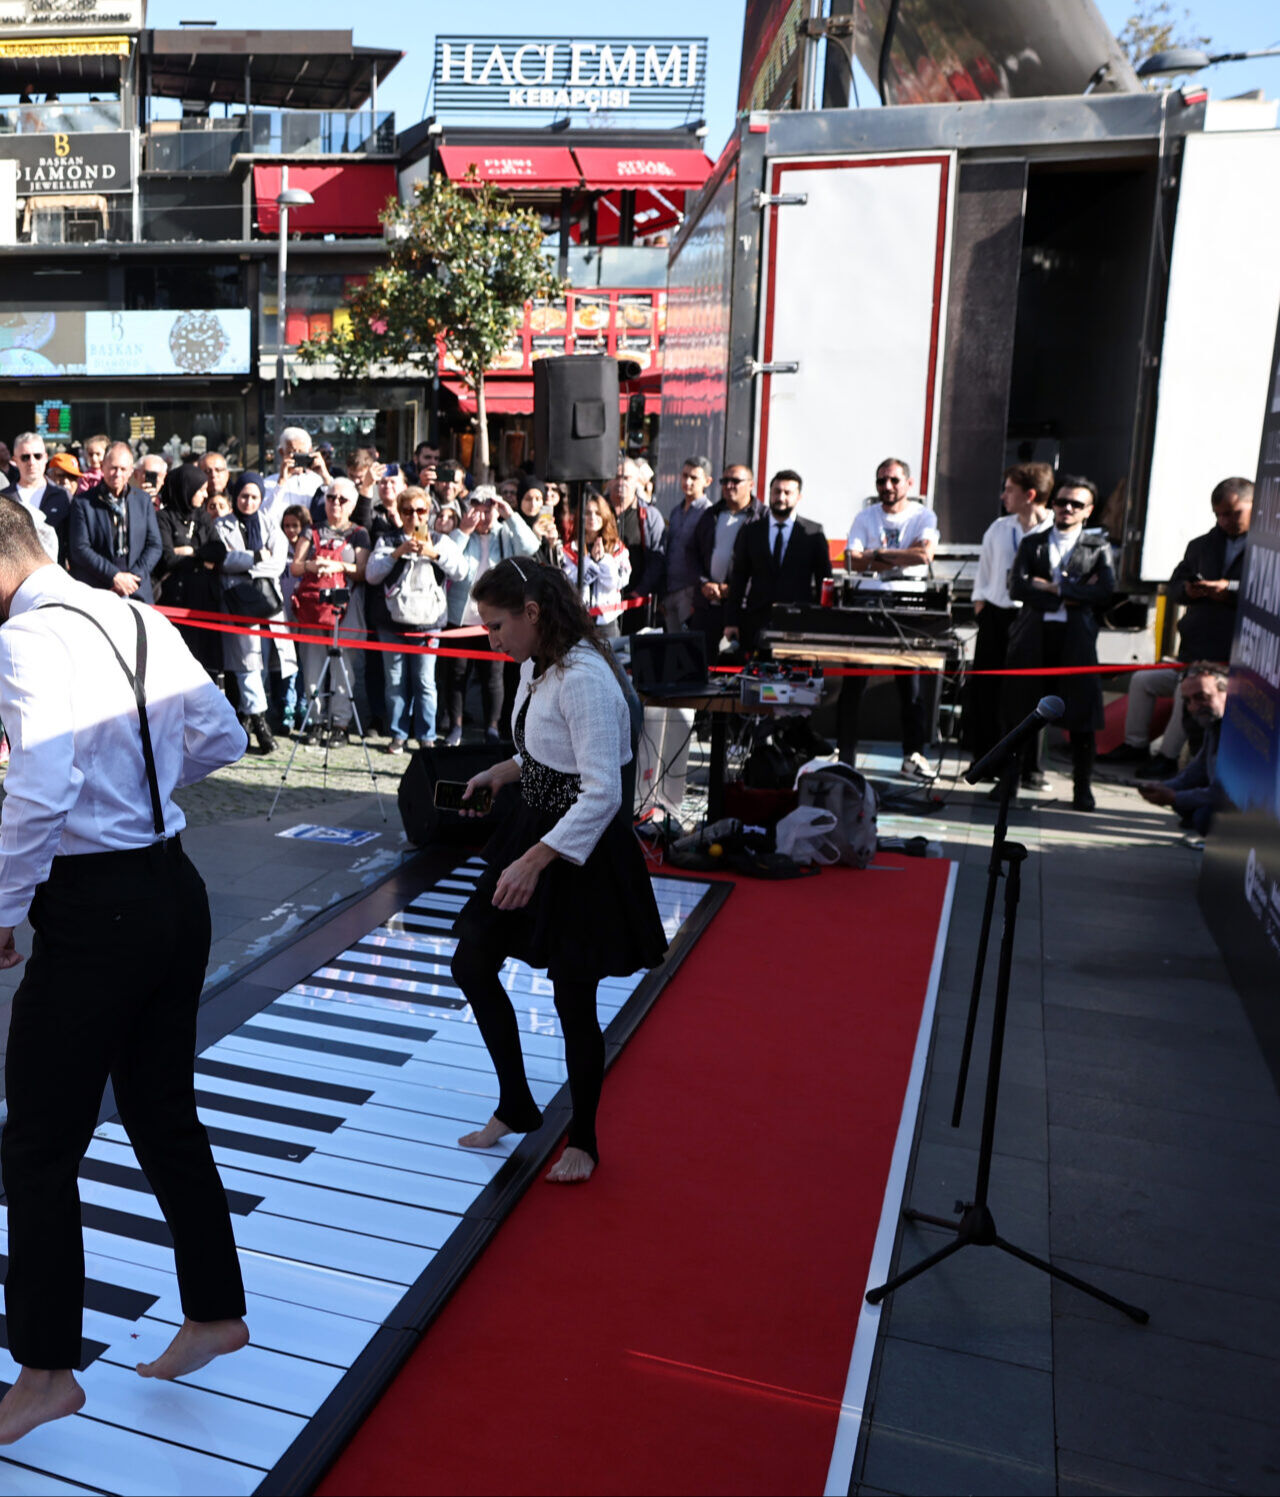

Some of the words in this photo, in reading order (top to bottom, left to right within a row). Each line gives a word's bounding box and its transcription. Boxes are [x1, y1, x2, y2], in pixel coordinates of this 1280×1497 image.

[438, 43, 558, 86] HACI
[565, 43, 698, 87] EMMI
[508, 88, 630, 113] KEBAPÇISI
[39, 156, 84, 167] BAŞKAN
[30, 180, 95, 192] JEWELLERY
